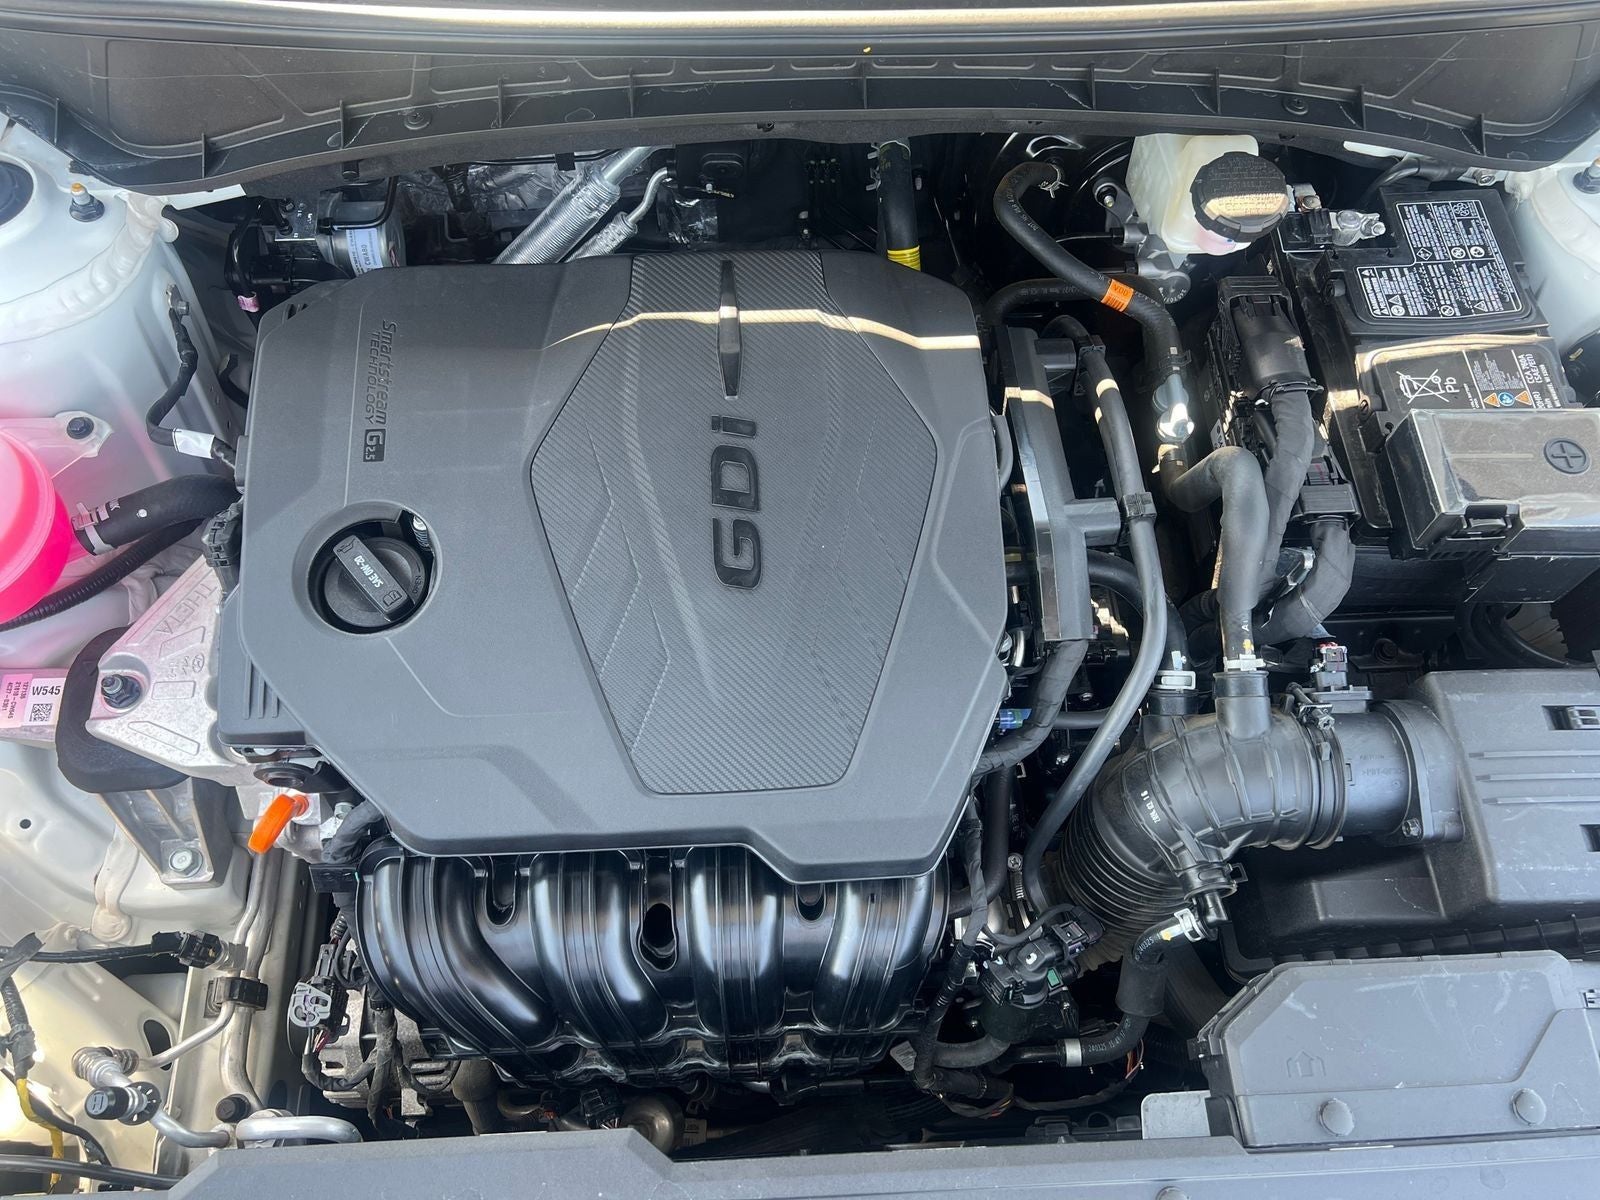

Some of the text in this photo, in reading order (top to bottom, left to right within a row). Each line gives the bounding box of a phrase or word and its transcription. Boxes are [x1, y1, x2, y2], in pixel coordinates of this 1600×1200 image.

[364, 332, 381, 425] TECHNOLOGY
[374, 320, 398, 425] Smartstream
[1446, 376, 1460, 393] Pb
[364, 429, 384, 462] G2.5
[353, 554, 384, 588] SAE 0W-20
[155, 583, 218, 635] THETA
[32, 685, 61, 696] W545
